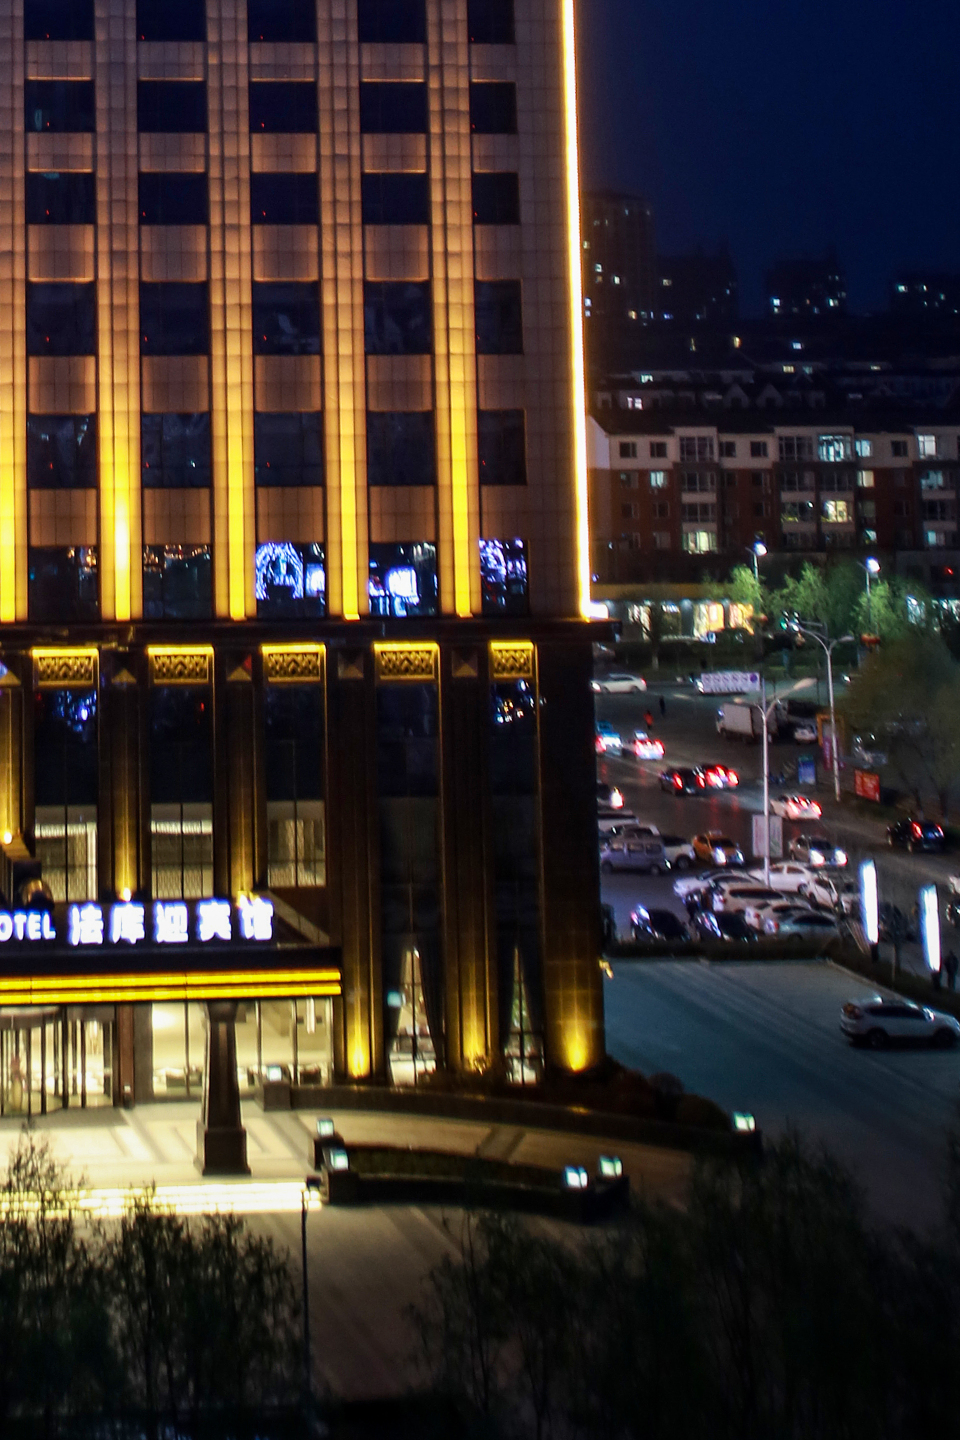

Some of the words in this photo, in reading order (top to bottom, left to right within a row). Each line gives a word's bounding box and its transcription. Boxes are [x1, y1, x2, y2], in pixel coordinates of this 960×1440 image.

[69, 899, 273, 945] 法库迎宾馆
